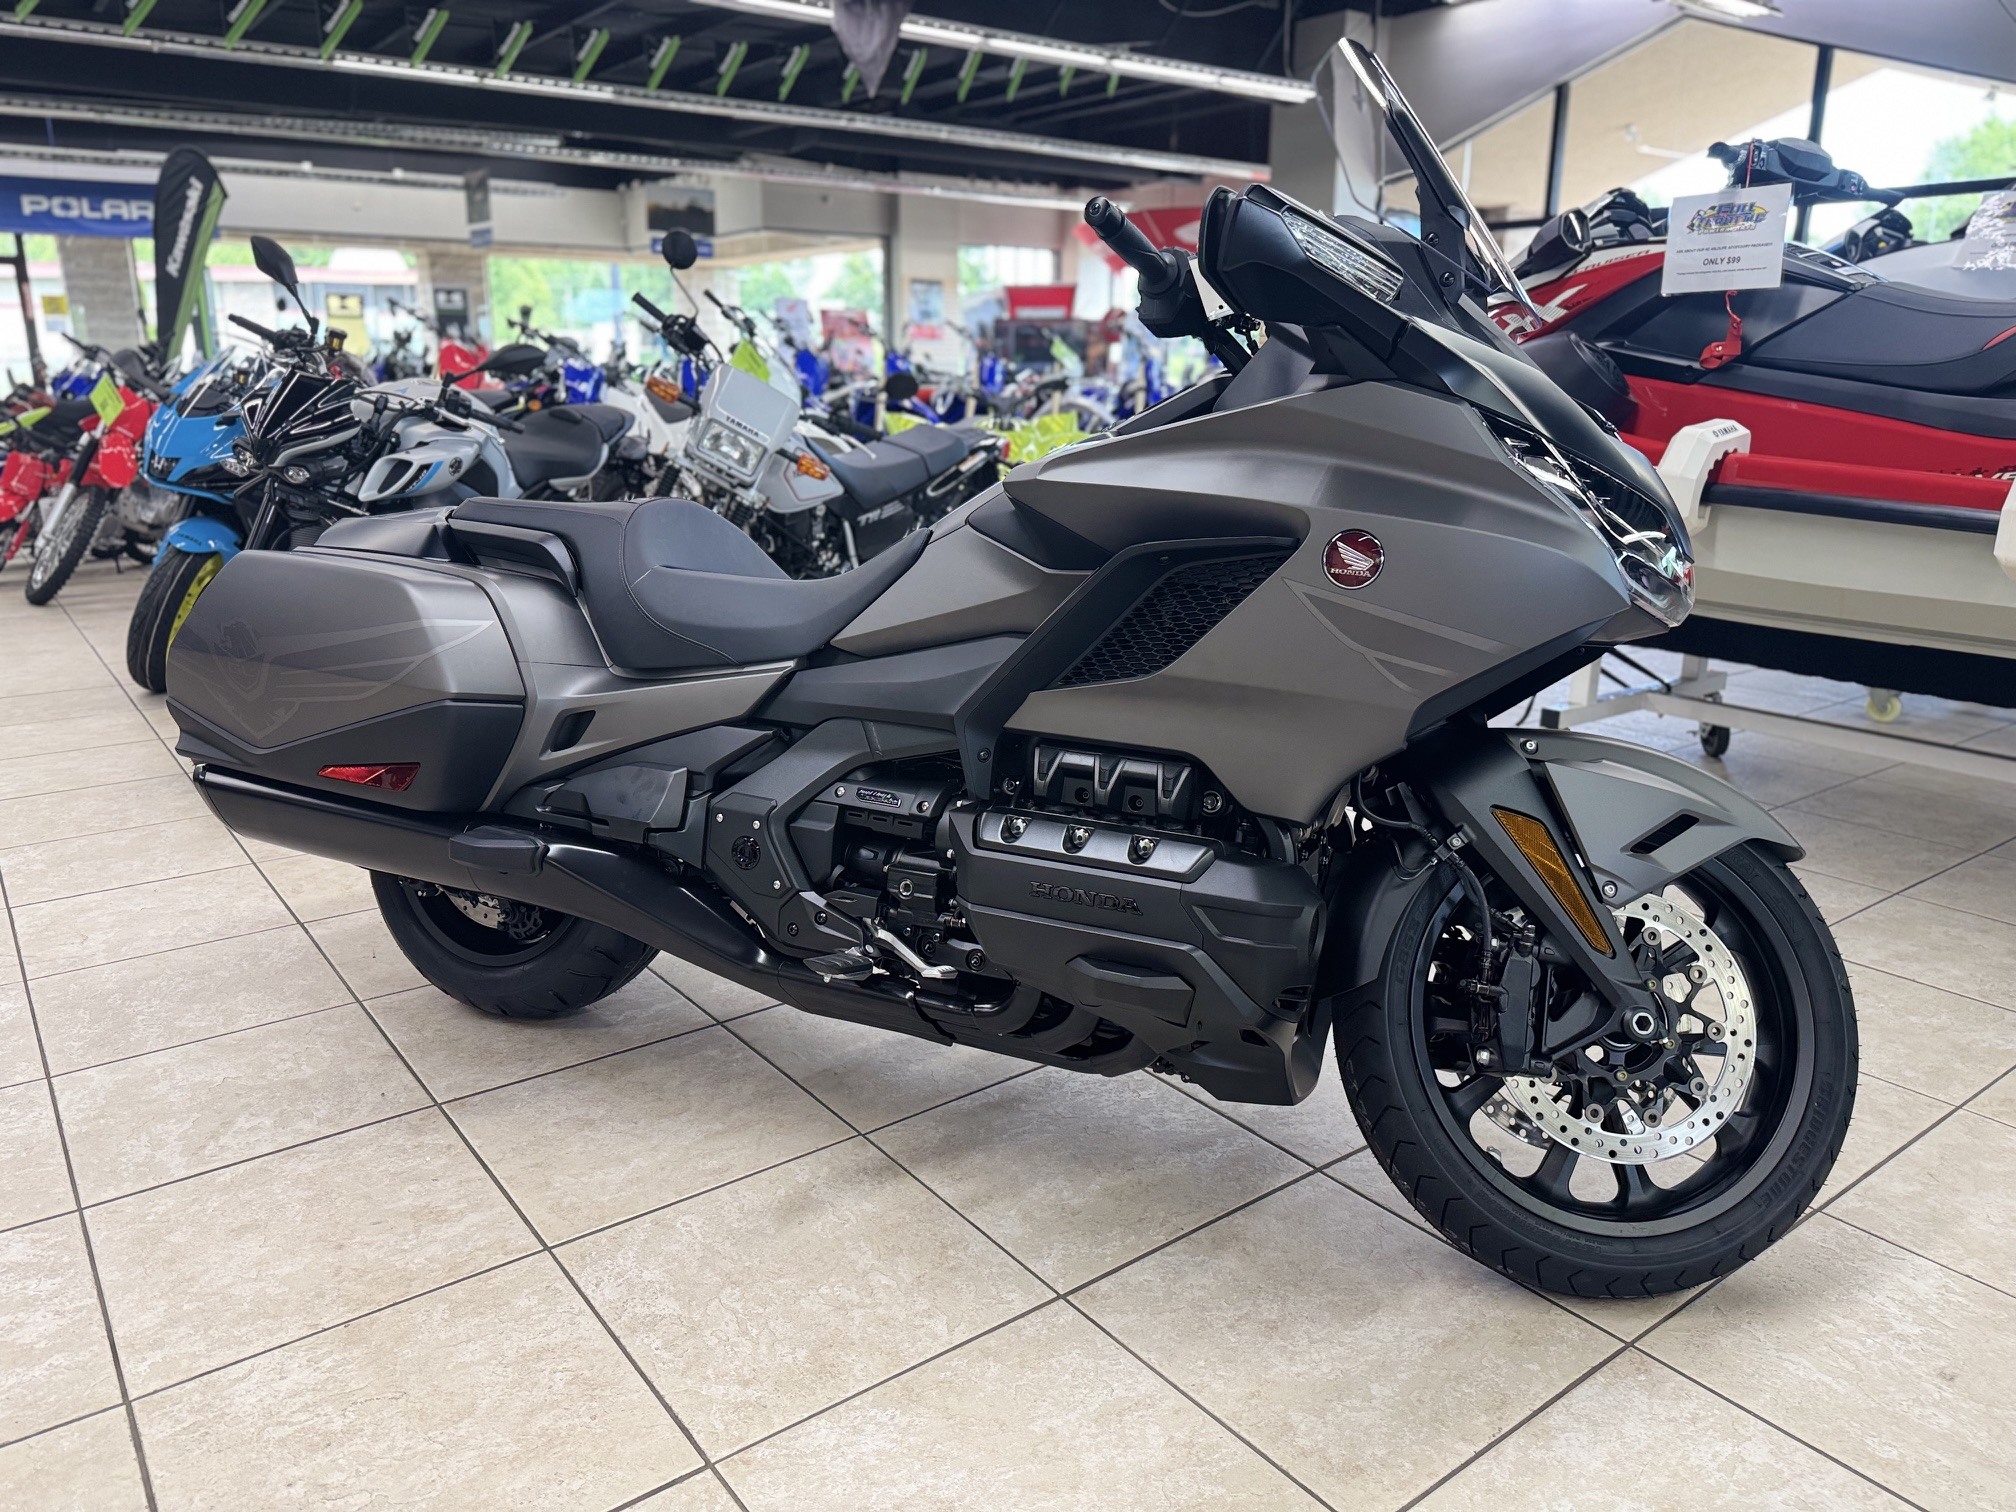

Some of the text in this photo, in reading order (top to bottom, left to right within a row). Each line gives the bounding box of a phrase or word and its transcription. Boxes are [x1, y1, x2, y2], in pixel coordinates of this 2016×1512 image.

[1703, 256, 1741, 266] ONLY $99
[726, 415, 759, 437] YAMAHA
[1330, 568, 1372, 578] HONDA
[1029, 881, 1144, 916] HONDA
